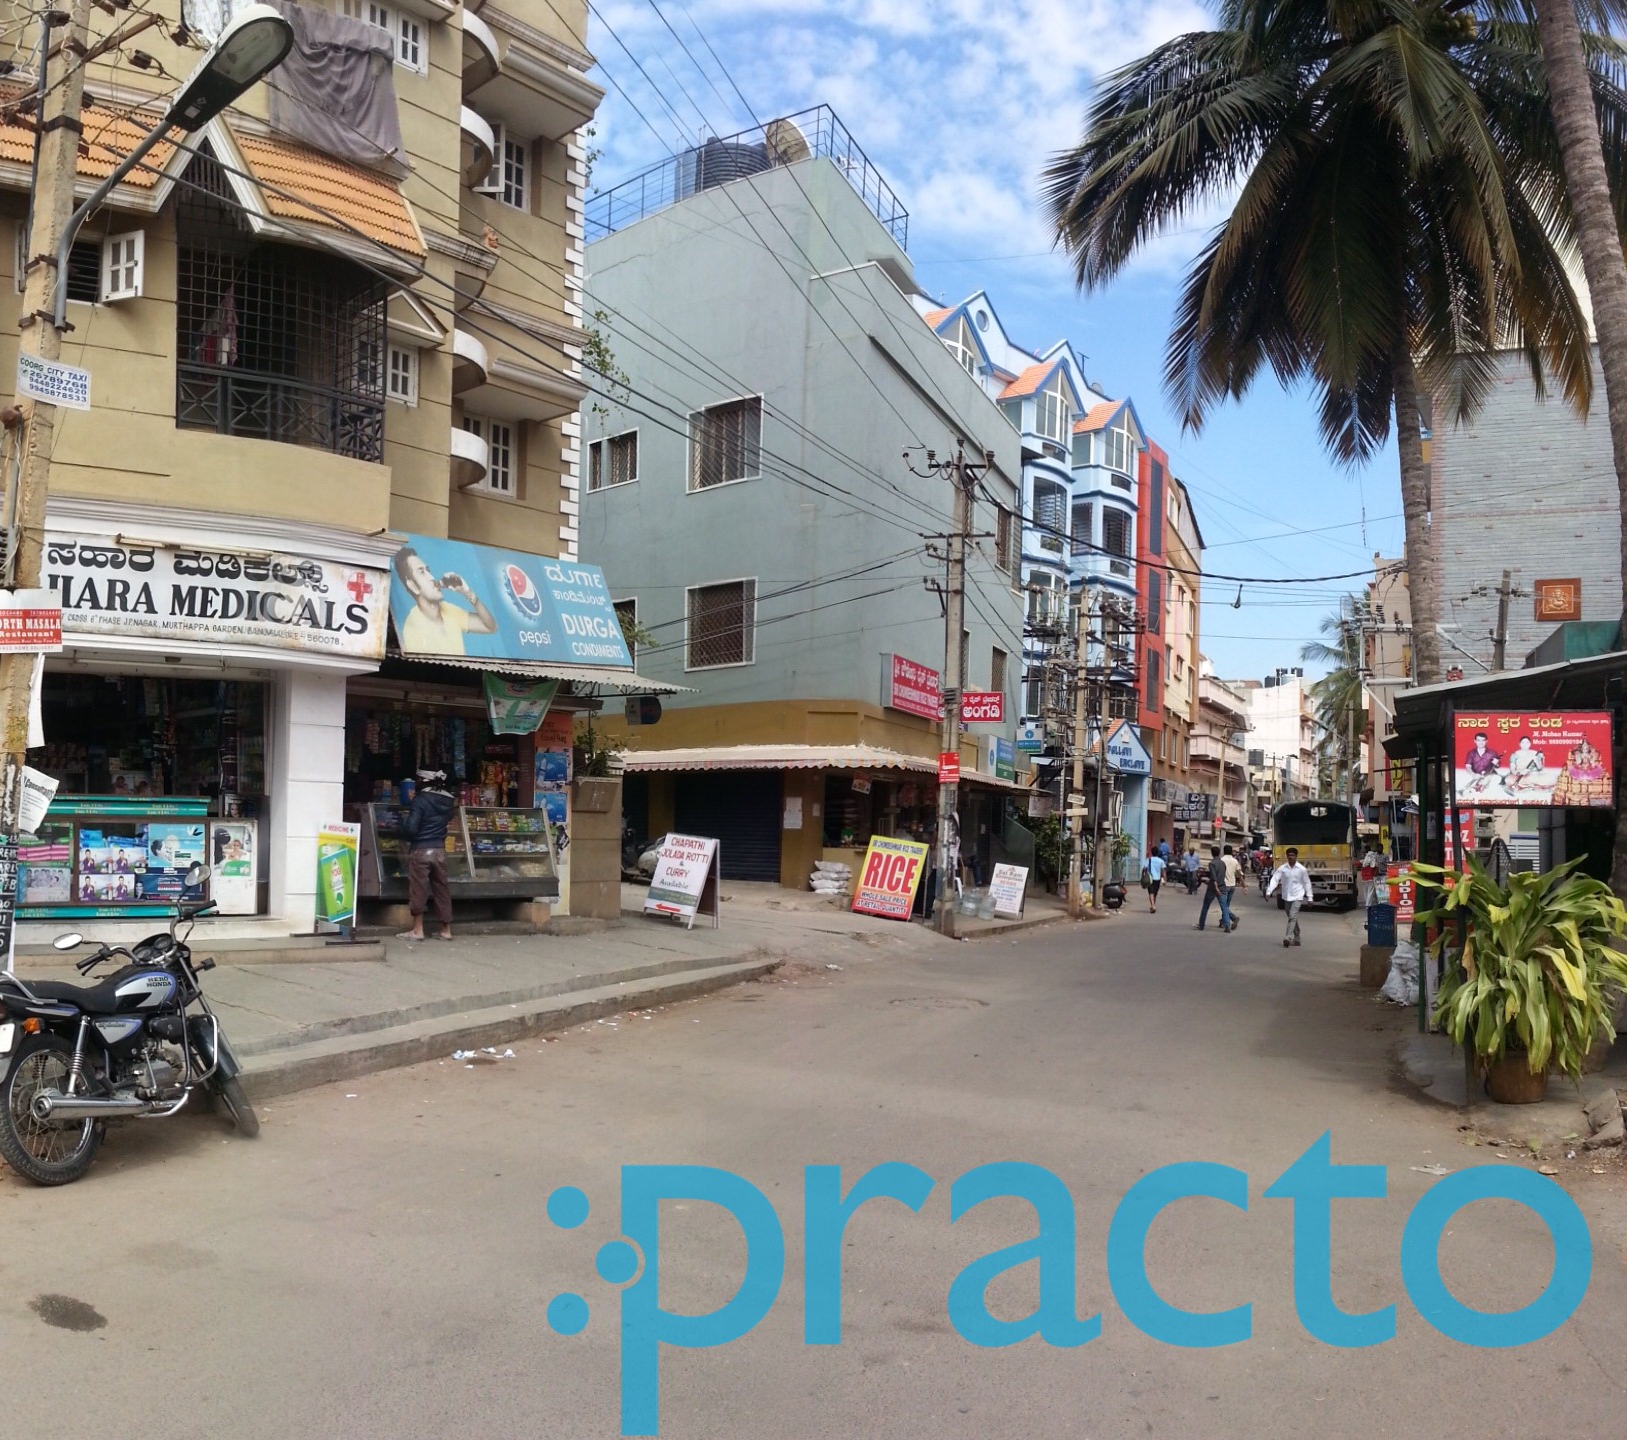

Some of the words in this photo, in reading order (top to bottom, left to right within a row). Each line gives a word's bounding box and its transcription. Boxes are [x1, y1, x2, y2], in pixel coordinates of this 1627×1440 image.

[20, 357, 44, 372] COORG
[47, 367, 65, 377] CITY
[67, 372, 87, 382] TAXI
[29, 370, 87, 389] 26789768
[29, 383, 87, 402] 9945878533
[48, 574, 158, 615] HARA
[169, 584, 369, 635] MEDICALS
[25, 618, 61, 629] MASALA
[98, 616, 121, 625] PHASE
[162, 620, 210, 632] MURTHAPPA
[561, 613, 621, 640] DURGA
[519, 629, 552, 647] pepsi
[571, 642, 624, 659] CONDIMENTS
[1458, 716, 1490, 728] ನಾದ
[1528, 716, 1563, 728] ತಂಡ
[328, 824, 349, 834] MEDICINE
[671, 837, 706, 850] CHAPATHI
[661, 848, 685, 860] JOLADA
[686, 852, 710, 864] ROTTI
[666, 866, 689, 878] CURRY
[863, 851, 919, 895] RICE
[659, 879, 689, 889] Available
[861, 891, 878, 900] WHOLE
[879, 894, 892, 902] SALE
[893, 896, 907, 905] PRICE
[863, 901, 881, 909] RETAIL
[882, 904, 906, 913] QUANTITY
